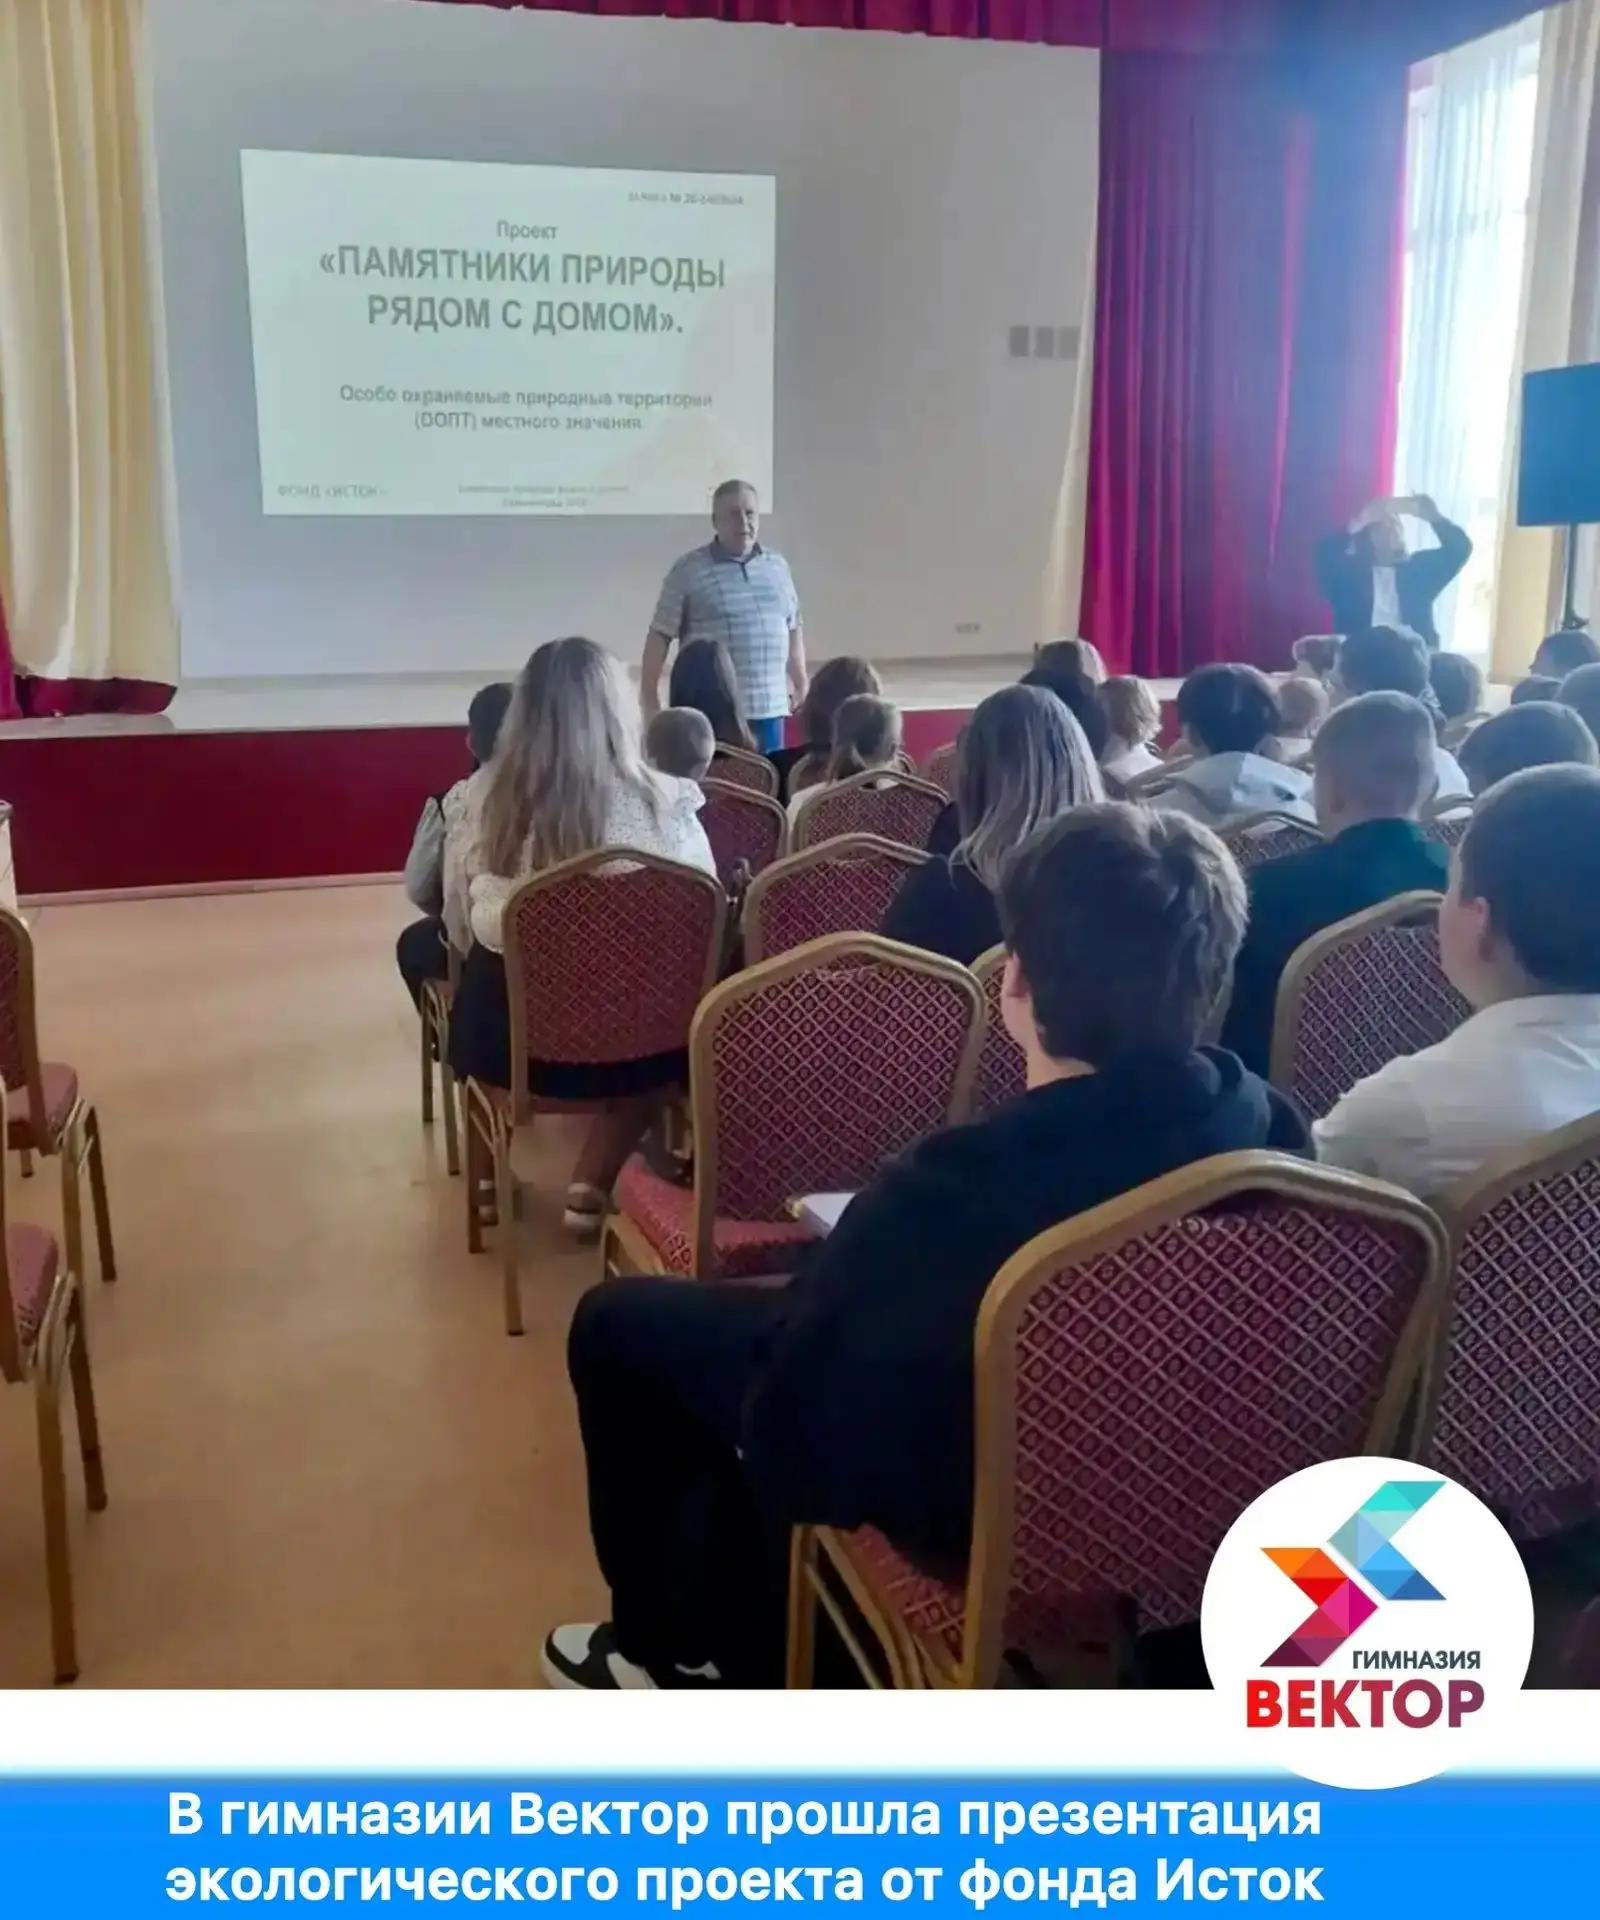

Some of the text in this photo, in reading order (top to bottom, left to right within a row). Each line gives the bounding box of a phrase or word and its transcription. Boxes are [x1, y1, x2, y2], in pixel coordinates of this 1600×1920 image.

[497, 221, 557, 241] Проект
[320, 245, 725, 293] «ПАМЯТНИКИ ПРИРОДЫ
[368, 296, 683, 336] РЯДОМ С ДОМОМ».
[340, 385, 396, 402] Особо
[482, 416, 559, 430] местного
